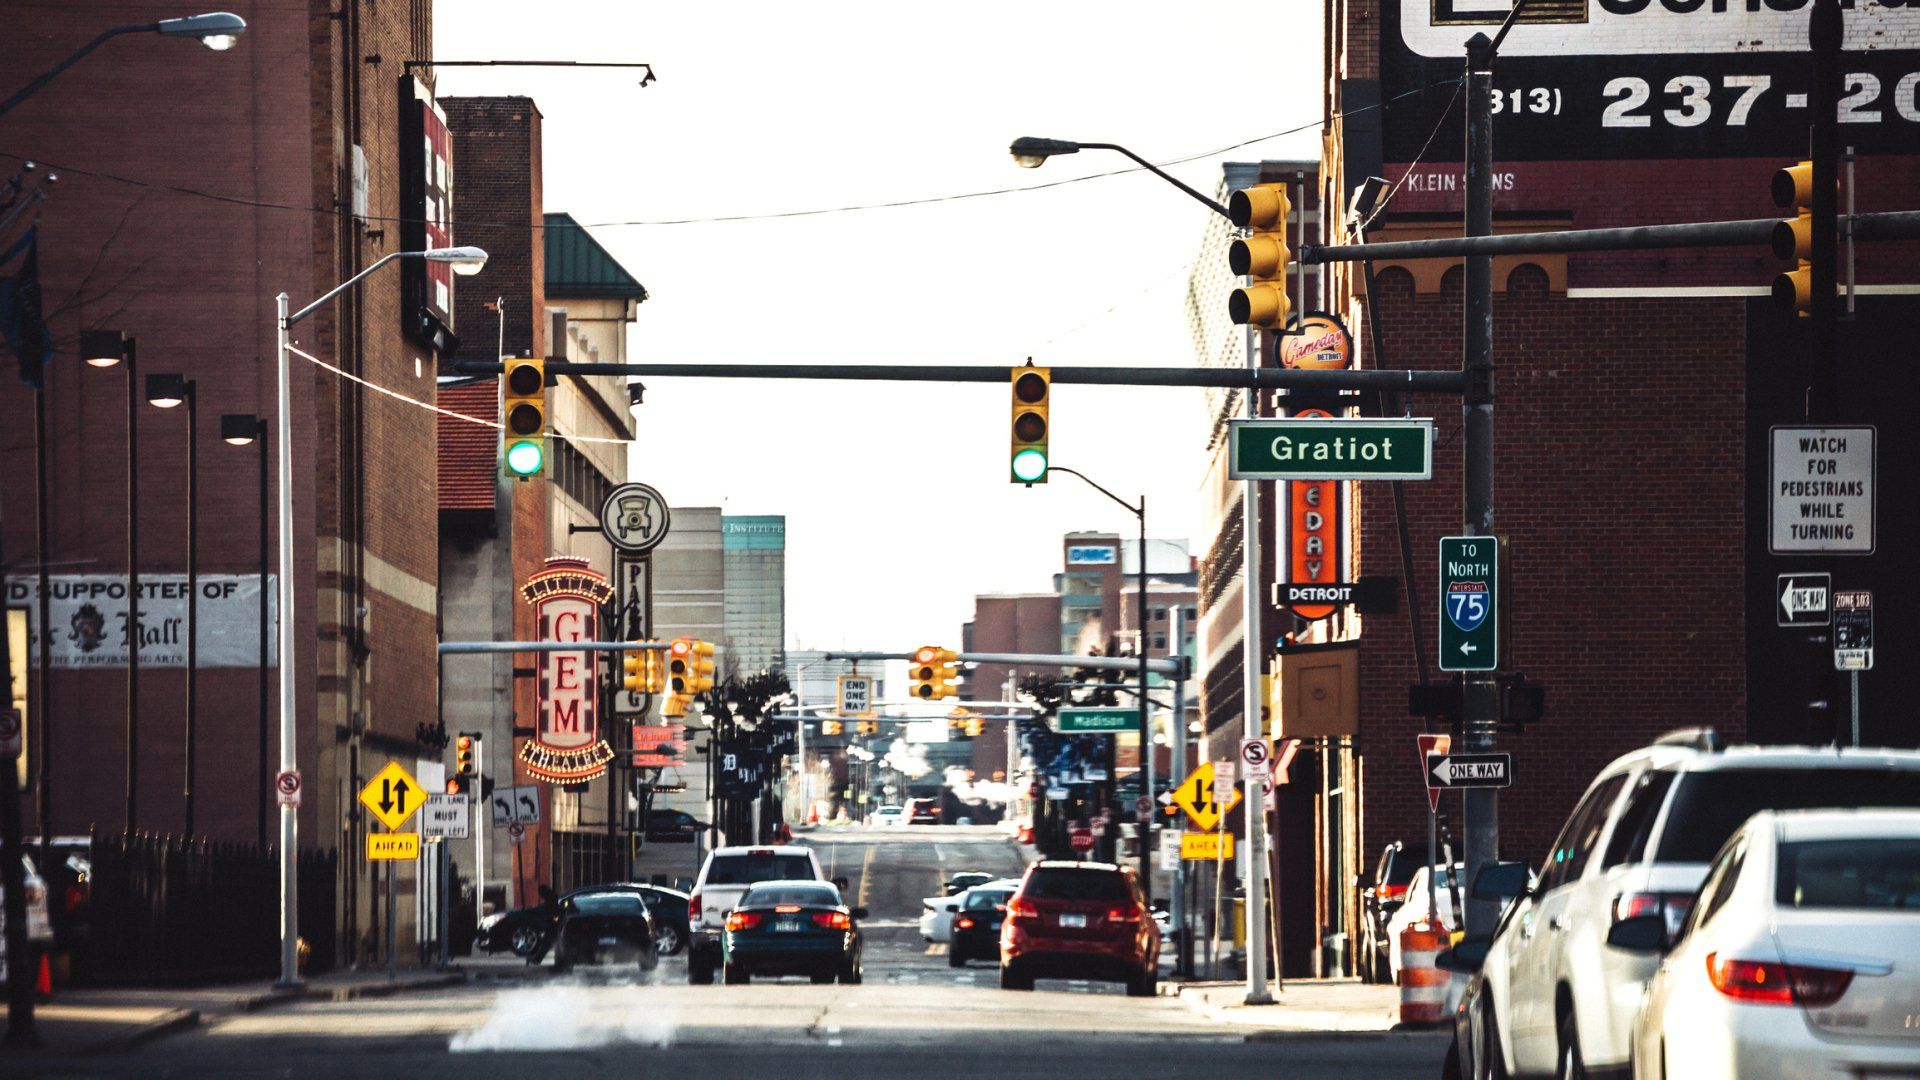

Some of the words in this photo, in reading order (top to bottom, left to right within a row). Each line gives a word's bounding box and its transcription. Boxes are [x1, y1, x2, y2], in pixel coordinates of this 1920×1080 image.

[1490, 88, 1562, 115] 313)
[1408, 174, 1455, 191] KLEIN
[1286, 330, 1342, 368] Gameday
[1271, 436, 1392, 461] Gratiot
[1799, 437, 1847, 453] WATCH
[1808, 459, 1836, 475] FOR
[1781, 481, 1863, 497] PEDESTRIANS
[1800, 503, 1844, 518] WHILE
[1790, 524, 1854, 540] TURNING
[1461, 544, 1477, 557] TO
[1449, 561, 1489, 576] NORTH
[203, 582, 238, 599] OF
[532, 577, 598, 596] LITTLE
[1289, 587, 1351, 601] DETROIT
[1452, 584, 1483, 592] INTERSTATE
[1451, 594, 1484, 620] 75
[1791, 590, 1807, 609] ONE
[1810, 590, 1824, 608] WAY
[1836, 595, 1854, 607] ZONE
[1856, 594, 1870, 607] 103
[553, 612, 579, 733] GEM
[846, 681, 865, 690] END
[846, 692, 865, 700] ONE
[845, 703, 865, 711] WAY
[1074, 716, 1125, 727] Madison
[527, 744, 600, 769] THEATRE
[1450, 764, 1473, 778] ONE
[1477, 763, 1501, 777] WAY
[448, 796, 465, 804] LANE
[435, 811, 457, 821] MUST
[449, 827, 464, 836] LEFT
[376, 842, 412, 851] AHEAD
